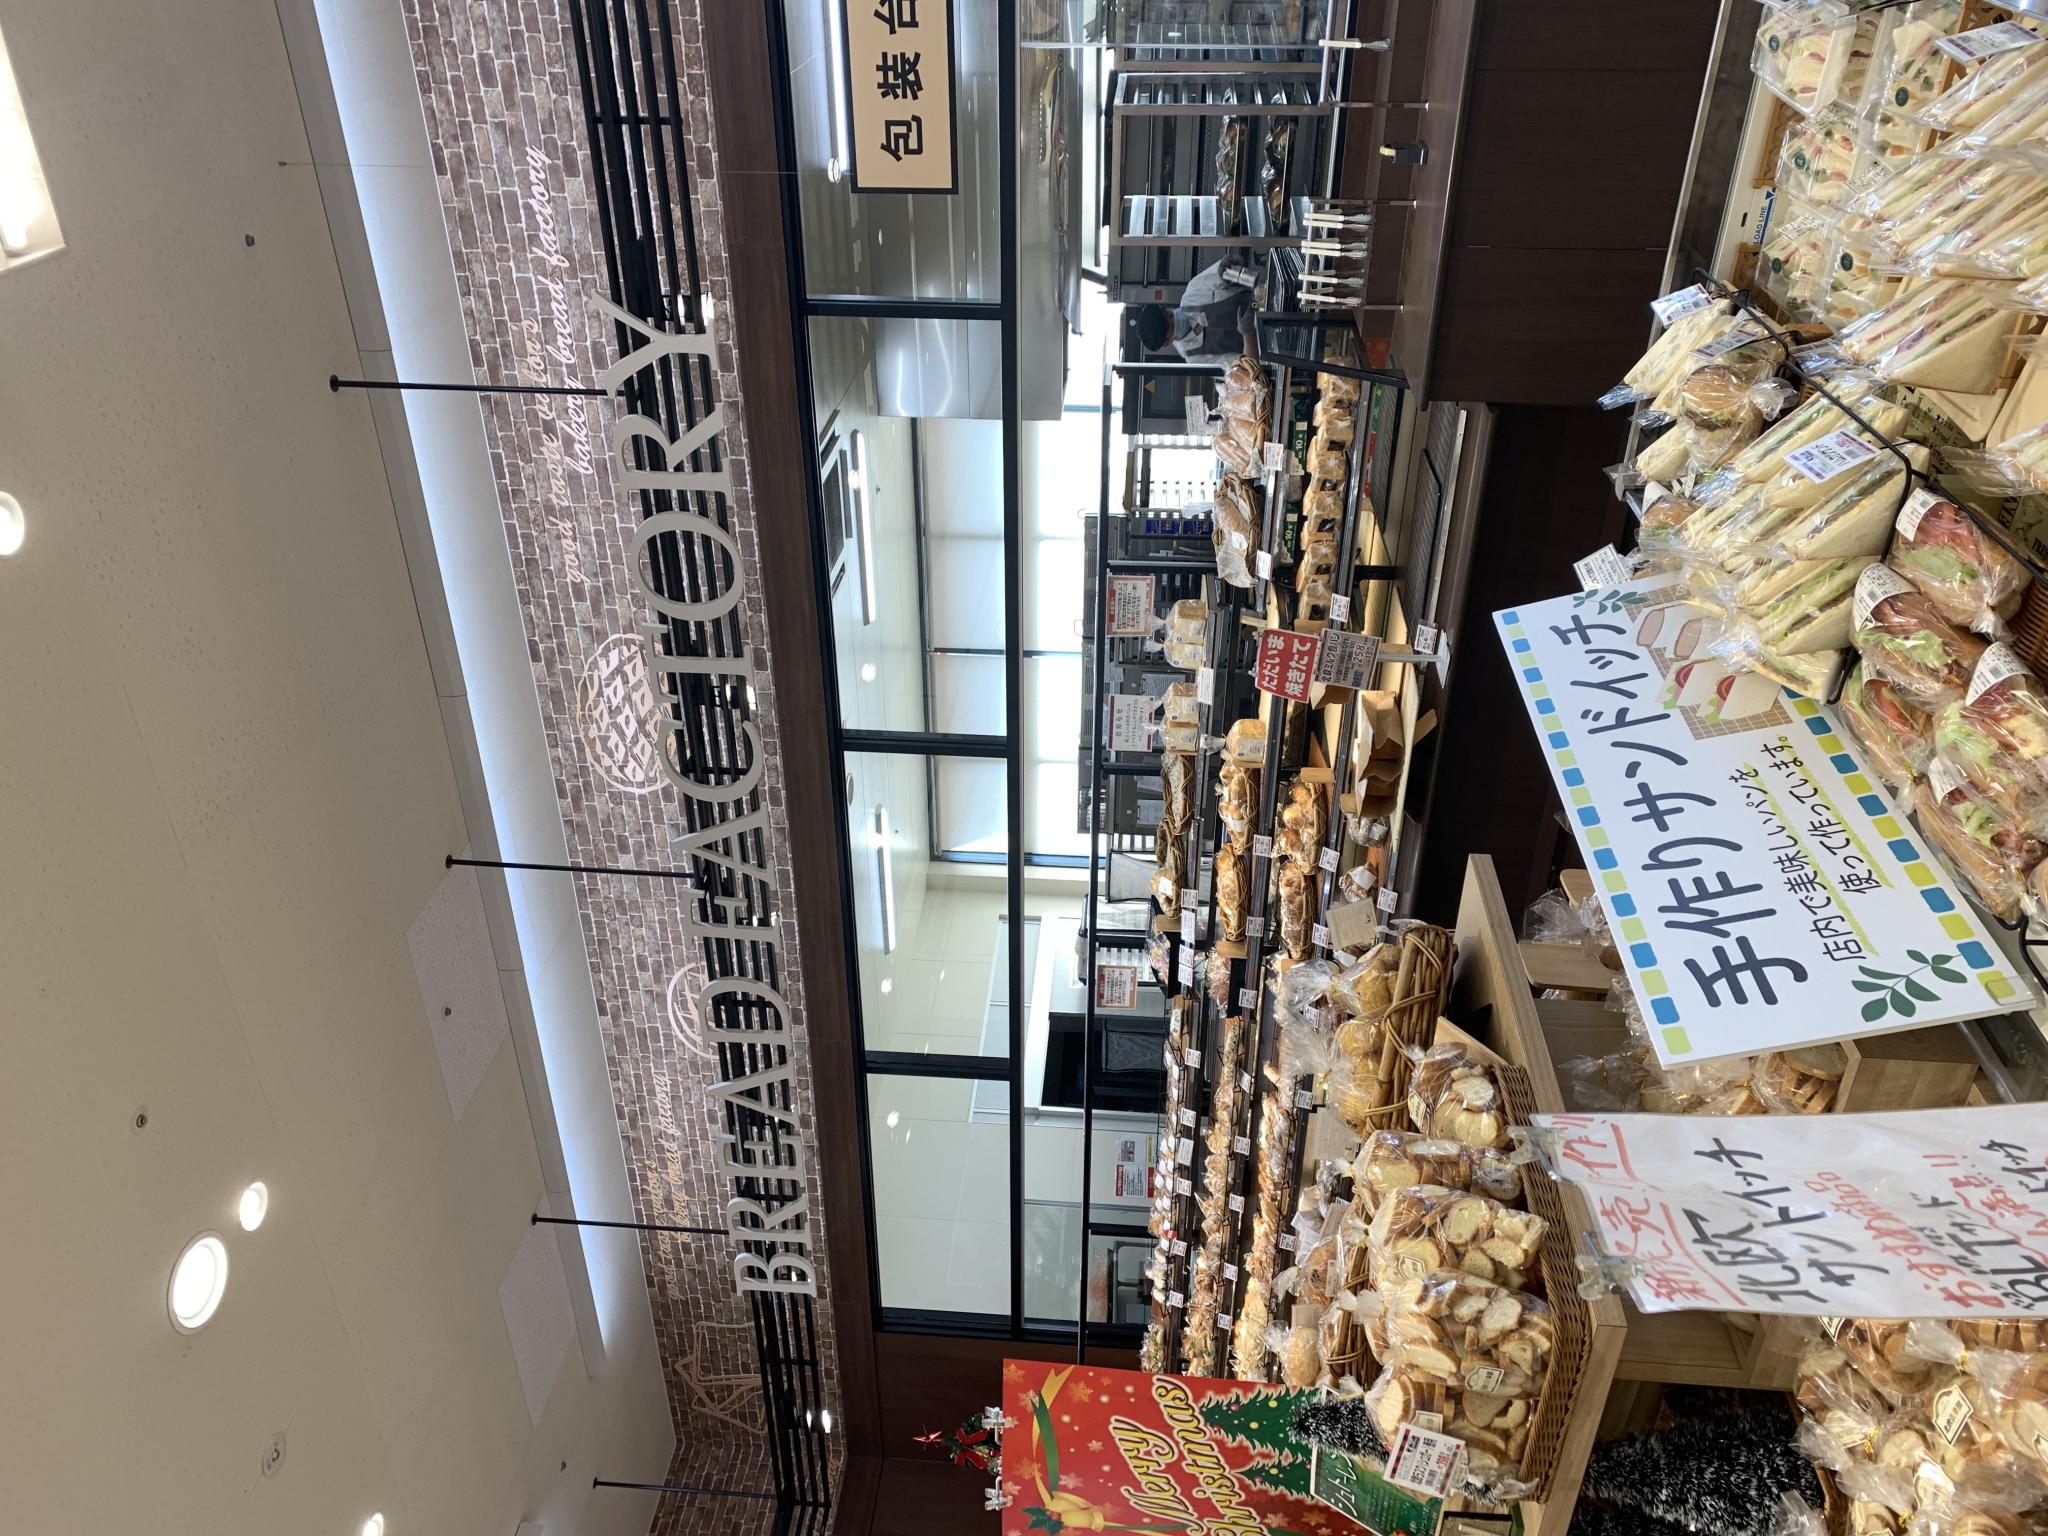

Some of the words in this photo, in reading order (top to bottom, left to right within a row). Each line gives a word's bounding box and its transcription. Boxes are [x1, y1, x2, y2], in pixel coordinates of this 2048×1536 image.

[873, 0, 924, 162] 包装台
[523, 145, 571, 267] factory
[1752, 224, 1762, 245] LOAD
[1758, 205, 1767, 222] LINE
[537, 278, 576, 364] bread
[541, 433, 569, 507] taste
[558, 376, 595, 475] bakery
[548, 517, 589, 584] good
[592, 291, 781, 951] FACTORY
[1262, 634, 1285, 690] ただいま
[1352, 645, 1366, 664] 258
[1285, 639, 1312, 697] 焼きたて
[1549, 614, 1809, 1008] 手作りサンドイッチ
[1760, 735, 1882, 894] 使って作っています。
[1728, 767, 1867, 962] 店内で美味しいパンを
[651, 1072, 681, 1136] factory
[697, 976, 818, 1298] BREAD
[659, 1141, 682, 1185] bread
[653, 1220, 673, 1259] tase
[667, 1192, 691, 1242] bkery
[1682, 1208, 1828, 1303] 北欧
[1694, 1137, 1890, 1286] サンドイッチ
[1111, 1417, 1204, 1534] Merry
